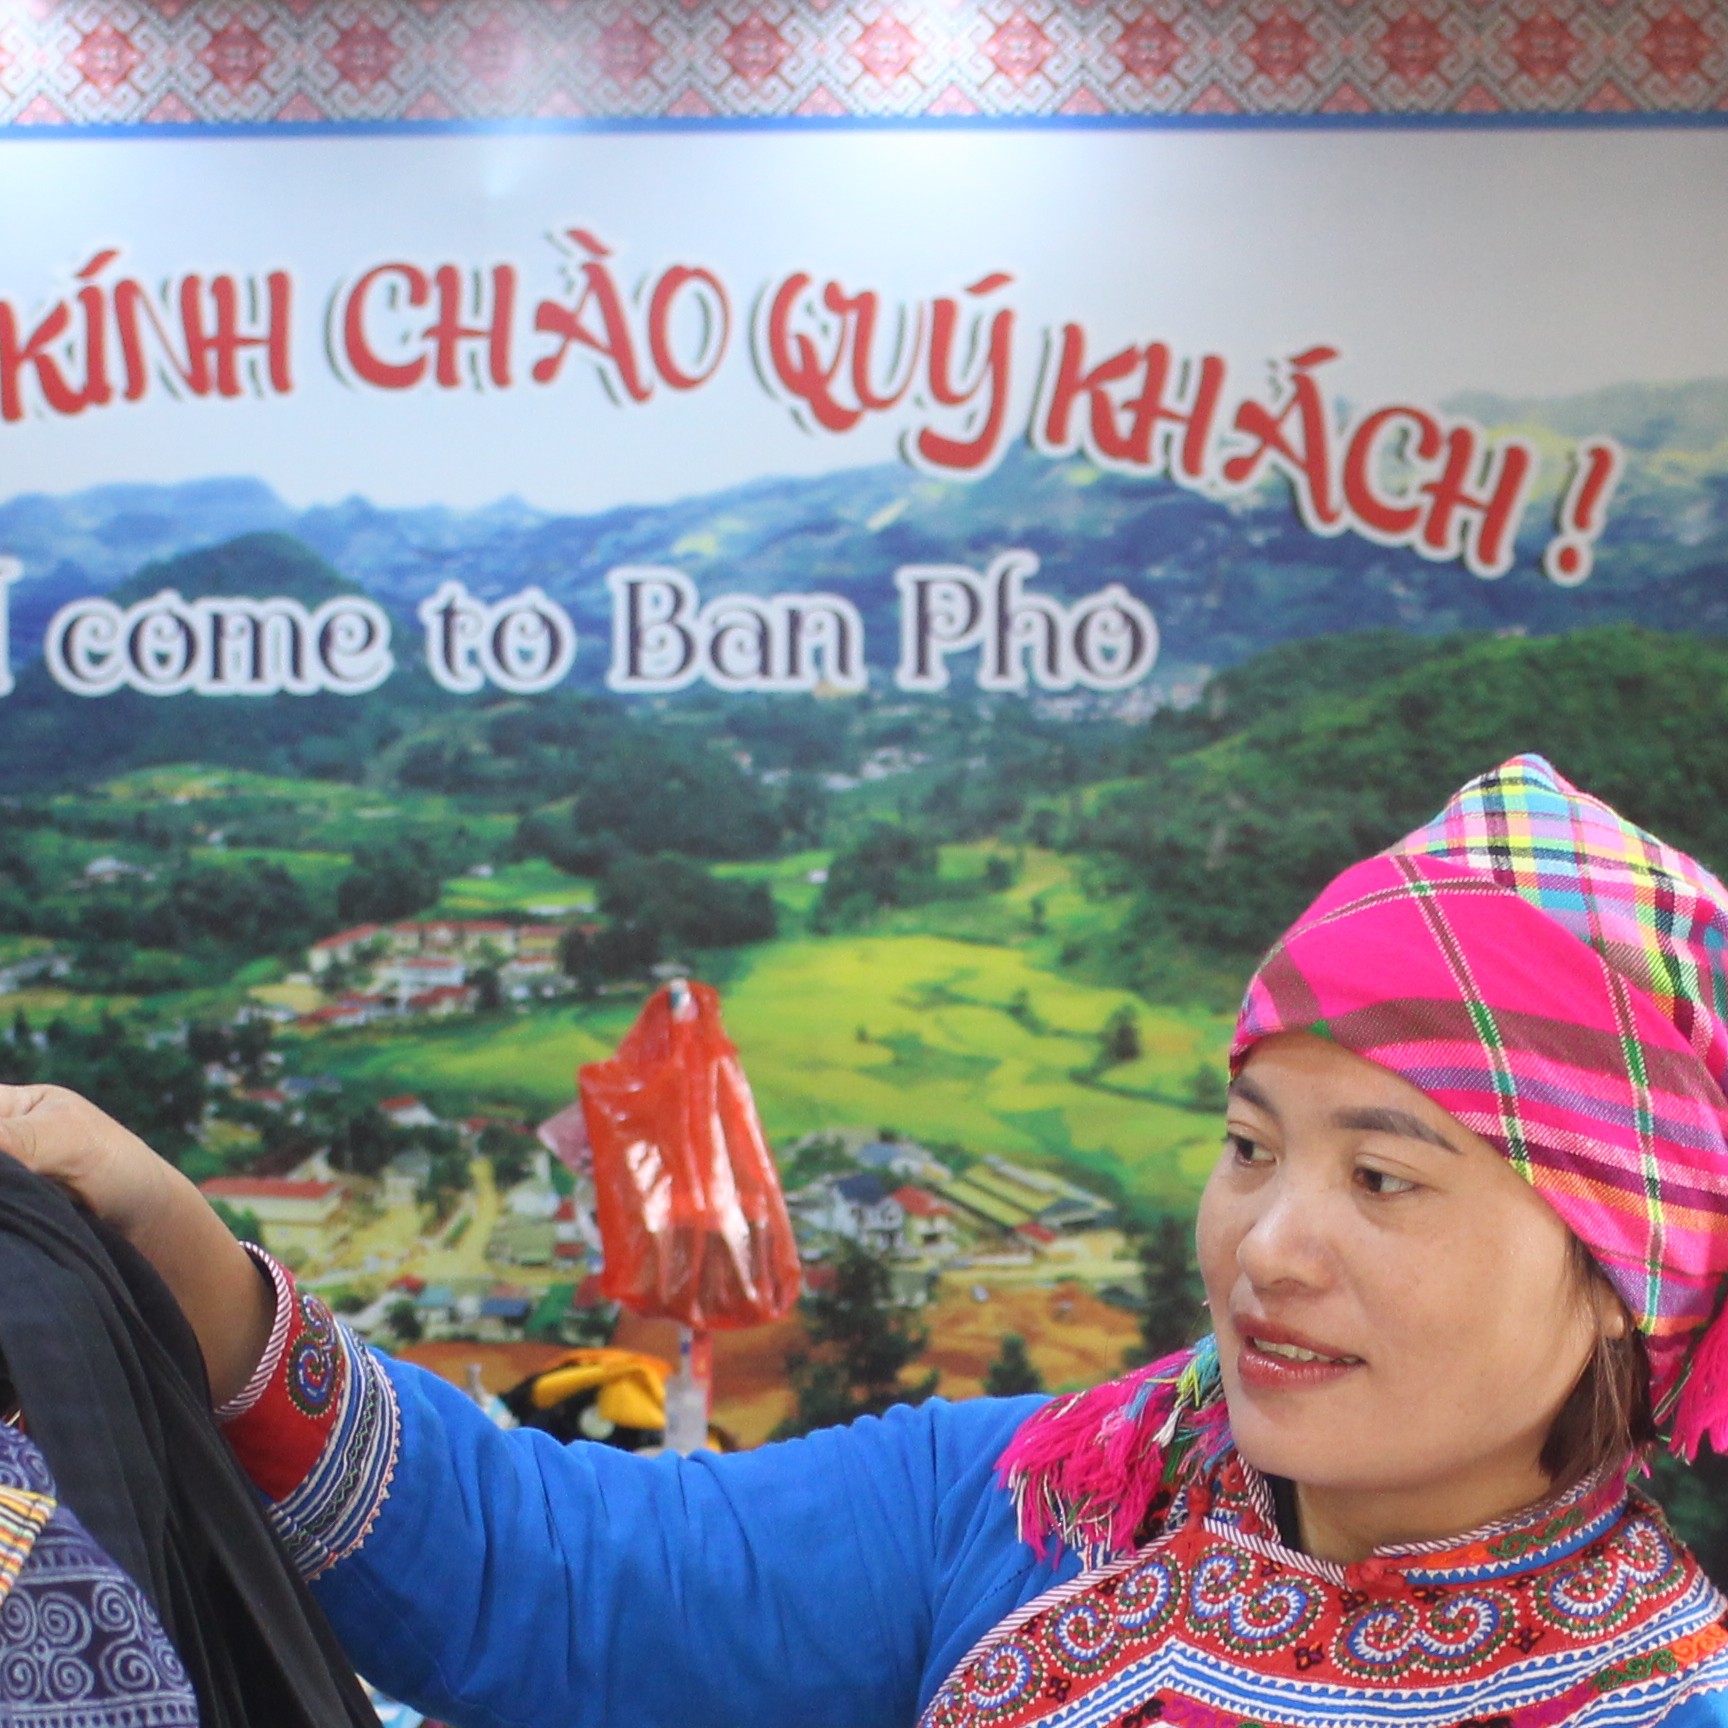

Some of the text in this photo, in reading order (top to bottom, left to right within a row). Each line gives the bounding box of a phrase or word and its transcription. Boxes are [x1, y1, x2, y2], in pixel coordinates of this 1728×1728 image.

[345, 230, 723, 401] CHÀO
[769, 273, 1015, 469] QUÝ
[1045, 346, 1530, 566] KHÁCH
[1558, 446, 1614, 574] !
[52, 596, 390, 692] come
[426, 584, 572, 688] to
[614, 570, 862, 688] Ban
[902, 556, 1154, 688] Pho
